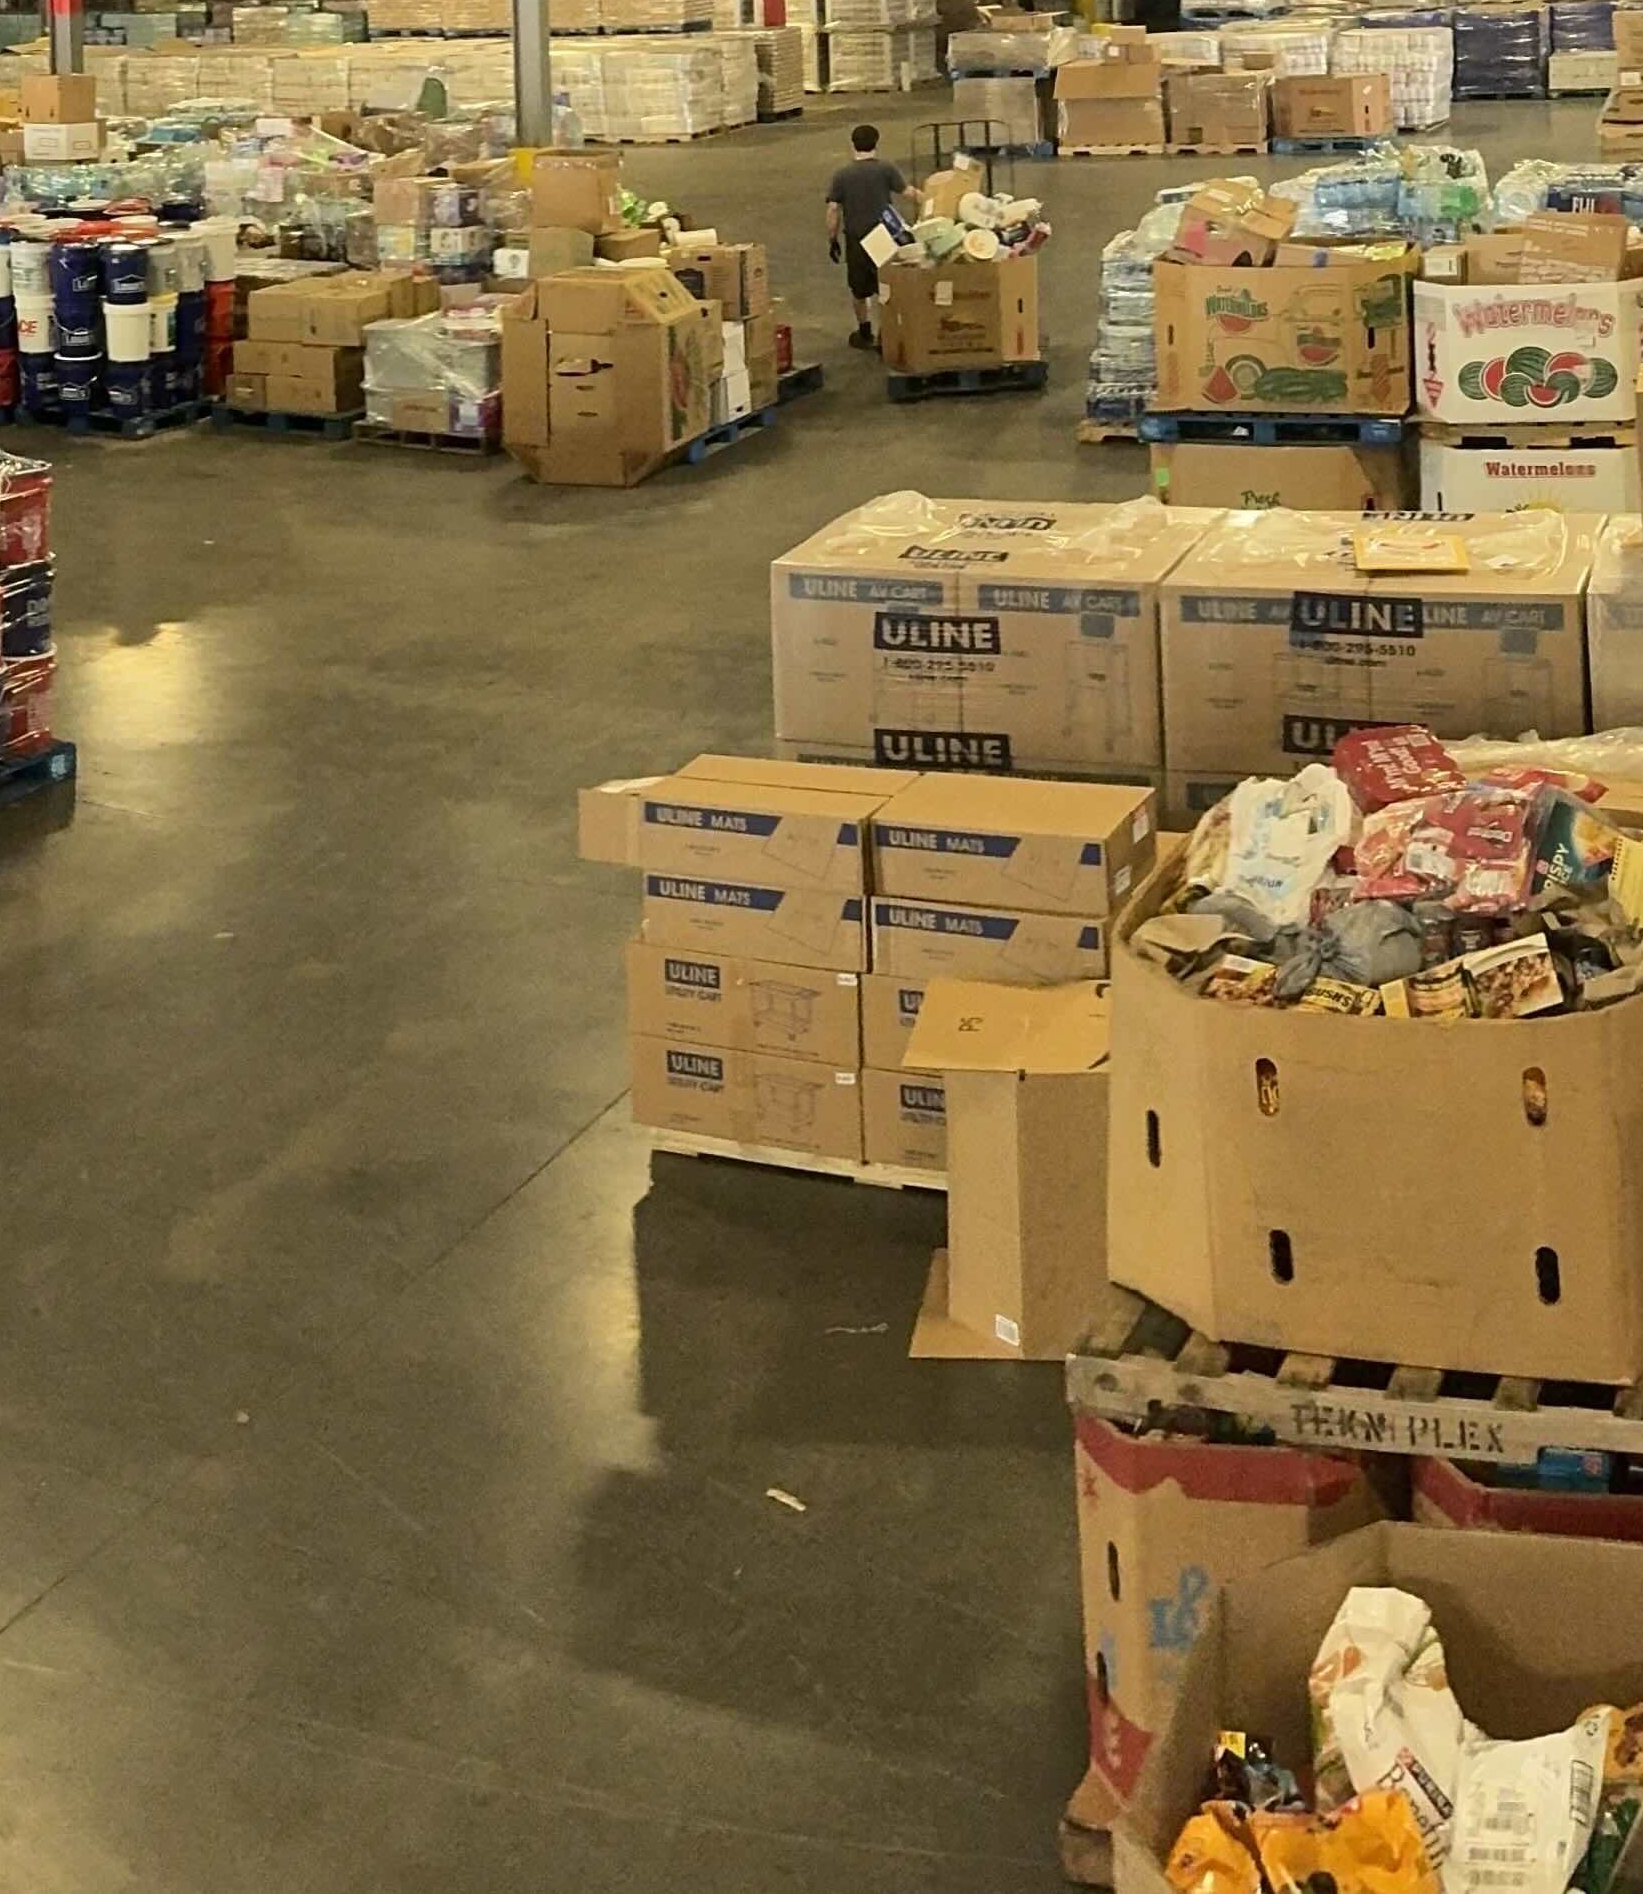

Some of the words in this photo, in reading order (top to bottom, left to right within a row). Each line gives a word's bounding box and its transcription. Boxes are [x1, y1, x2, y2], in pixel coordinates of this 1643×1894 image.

[1452, 298, 1616, 338] Watermelons
[1485, 461, 1596, 478] Watermelons
[803, 577, 858, 599] ULINE
[993, 589, 1050, 609] ULINE
[1198, 601, 1256, 620] ULINE
[1299, 599, 1414, 632] ULINE
[1423, 607, 1467, 624] LINE
[881, 617, 993, 649] ULINE
[883, 734, 1002, 767] ULINE
[656, 807, 702, 827] ULINE
[711, 815, 747, 832] MATS
[889, 830, 938, 849] ULINE
[946, 837, 985, 853] MATS
[659, 880, 705, 900] ULINE
[713, 888, 751, 906] MATS
[889, 909, 936, 929] ULINE
[945, 917, 983, 934] MATS
[669, 966, 718, 985] ULINE
[671, 1058, 721, 1078] ULINE
[1408, 1414, 1504, 1454] PLEX
[1412, 1756, 1453, 1819] PURINA
